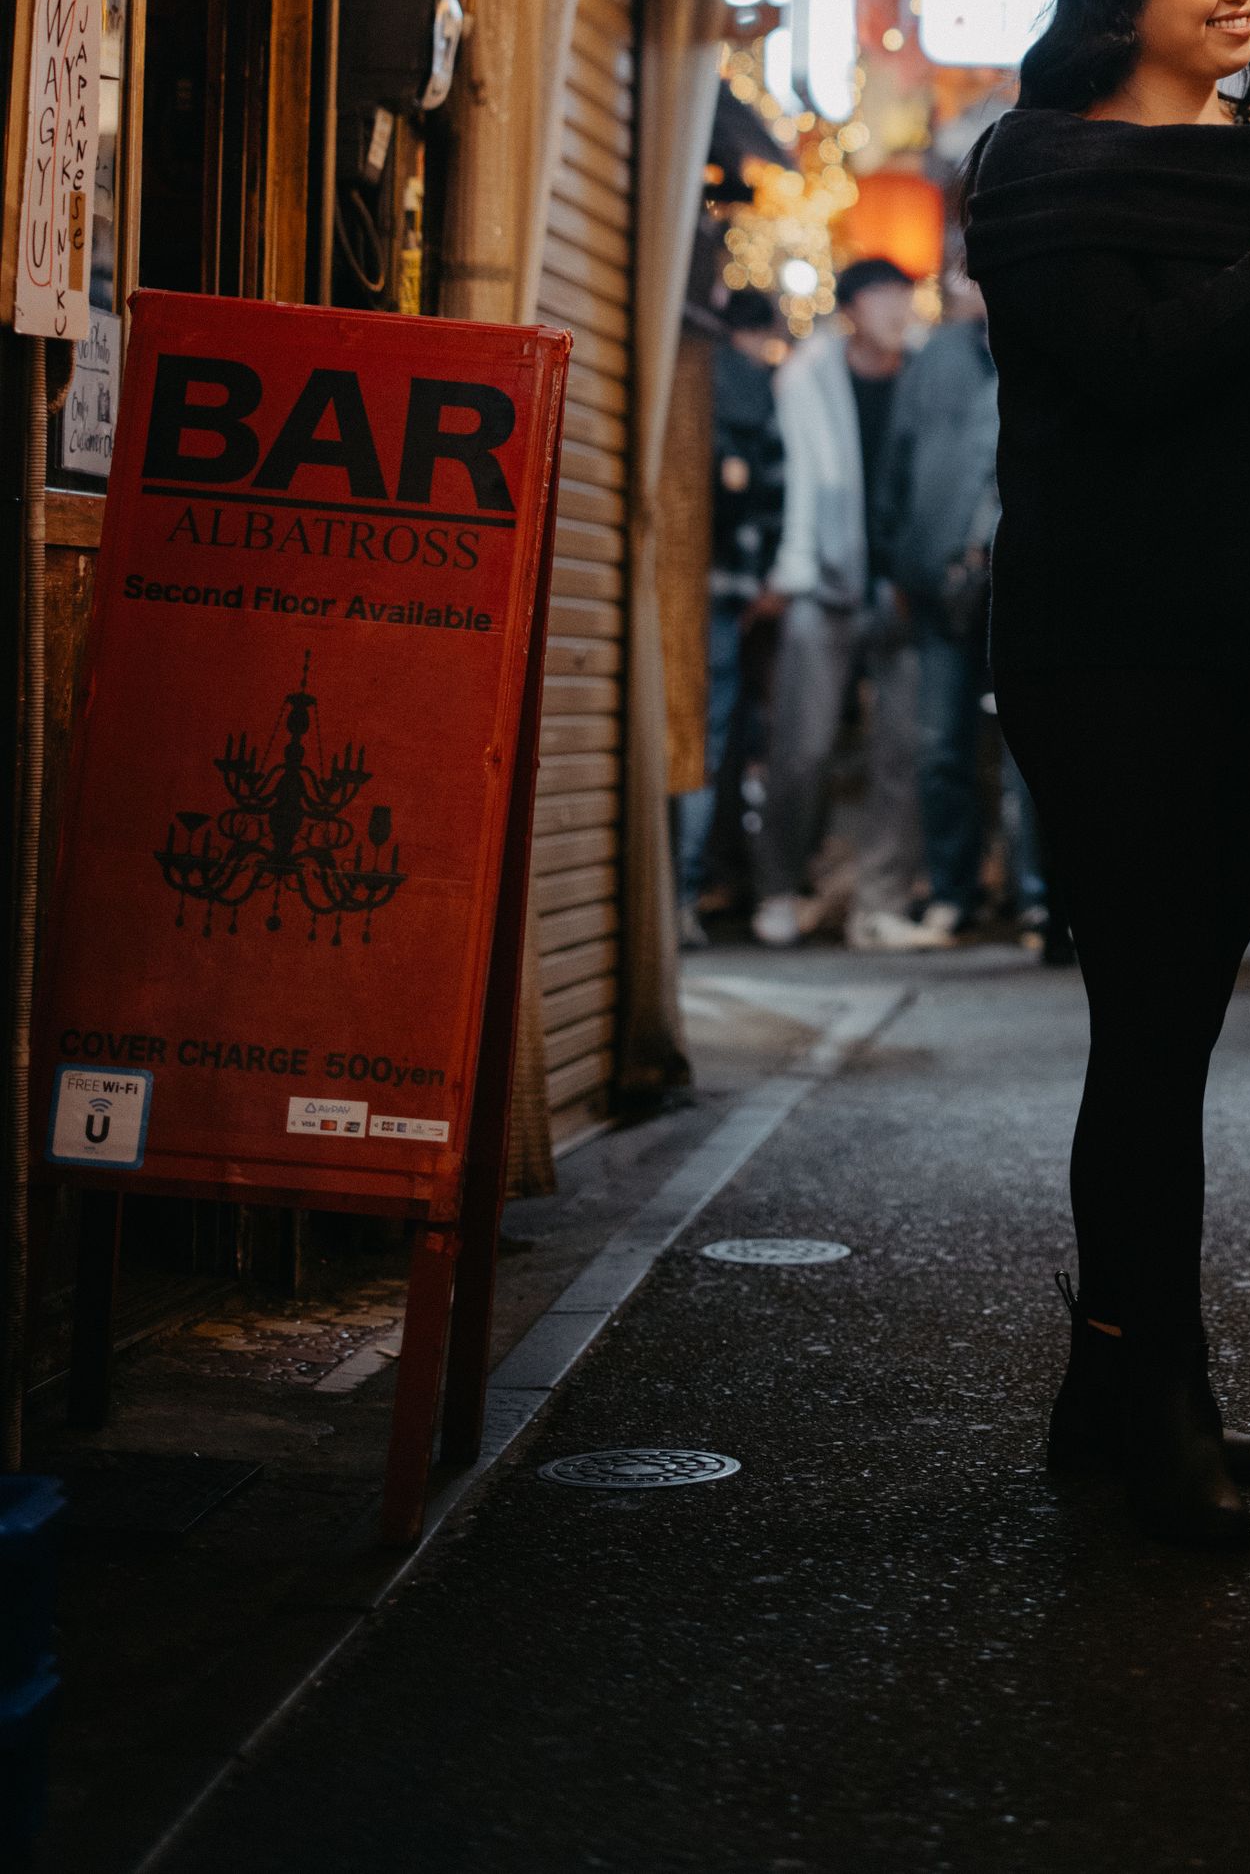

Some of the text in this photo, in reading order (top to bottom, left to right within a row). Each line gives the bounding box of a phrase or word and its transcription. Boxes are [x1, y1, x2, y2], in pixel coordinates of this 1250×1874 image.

[54, 56, 76, 337] YAKINIKU
[142, 352, 516, 511] BAR
[165, 505, 481, 570] ALBATROSS
[123, 574, 493, 632] Second Floor Available
[59, 1028, 446, 1088] COVER CHARGE 500yen
[67, 1077, 138, 1095] FREE Wi-Fi
